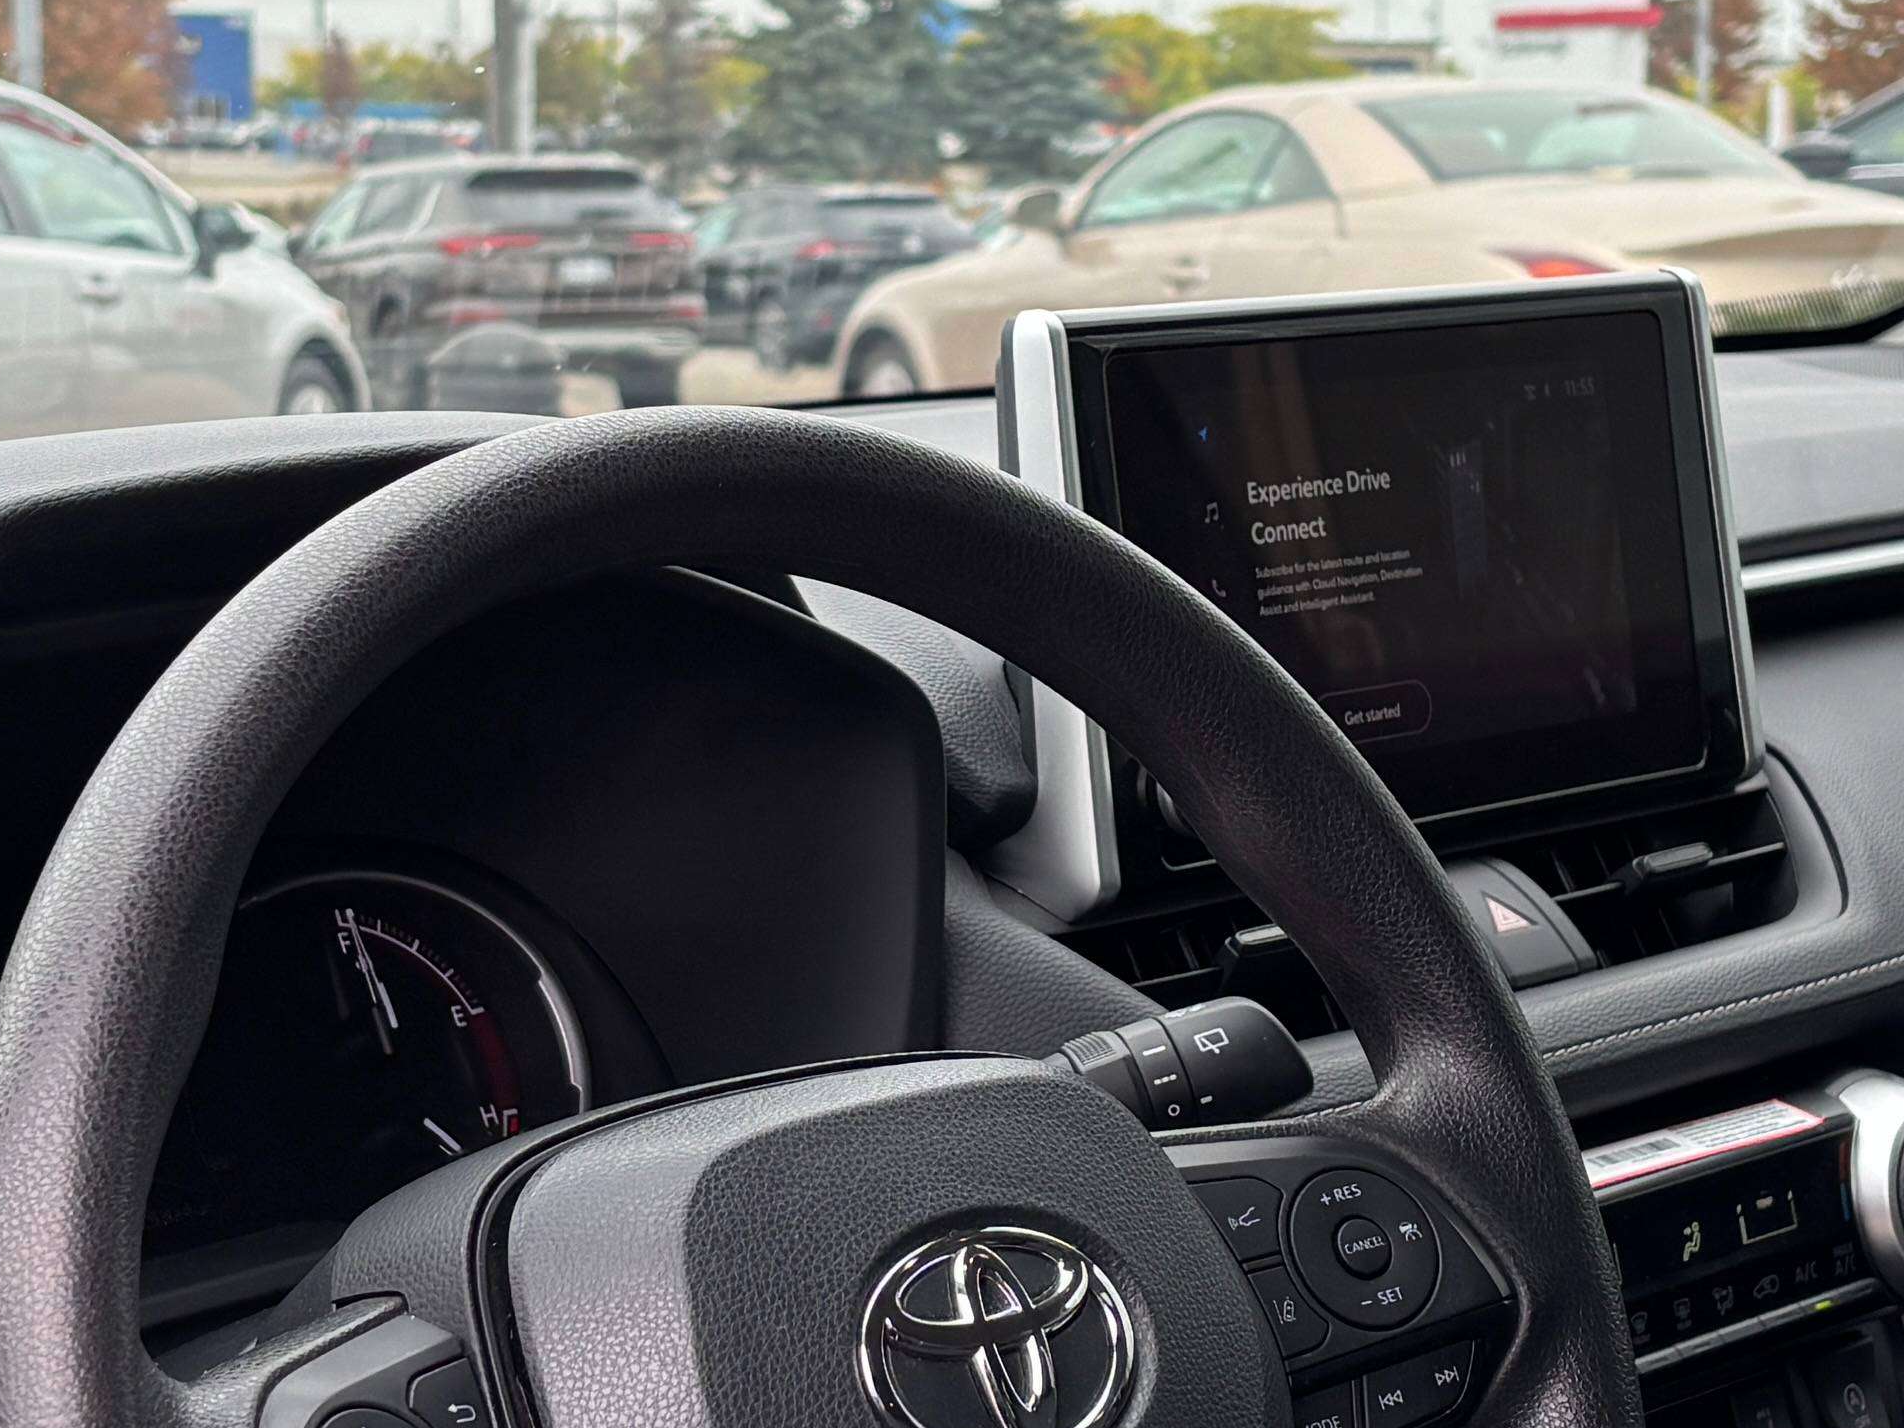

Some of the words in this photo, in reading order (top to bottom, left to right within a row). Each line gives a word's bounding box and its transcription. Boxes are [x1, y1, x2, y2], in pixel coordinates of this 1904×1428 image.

[1247, 474, 1344, 507] Experience
[1346, 468, 1392, 494] Drive
[1251, 516, 1327, 545] Connect
[1307, 560, 1319, 573] the
[1320, 557, 1343, 570] latest
[1344, 555, 1363, 567] route
[1365, 552, 1379, 565] and
[1380, 549, 1410, 563] location
[1257, 584, 1294, 600] guidance
[1295, 582, 1311, 593] with
[1313, 576, 1336, 590] Cloud
[1380, 567, 1423, 581] Destination
[1260, 605, 1282, 616] Assist
[1283, 602, 1298, 613] and
[1299, 597, 1338, 612] Intelligent
[1344, 708, 1364, 726] Get
[1365, 703, 1402, 722] started
[337, 932, 351, 953] F
[451, 1005, 467, 1027] E
[480, 1104, 499, 1128] H
[1334, 1183, 1362, 1203] RES
[1344, 1235, 1388, 1254] CANCEL
[1377, 1286, 1404, 1306] SET
